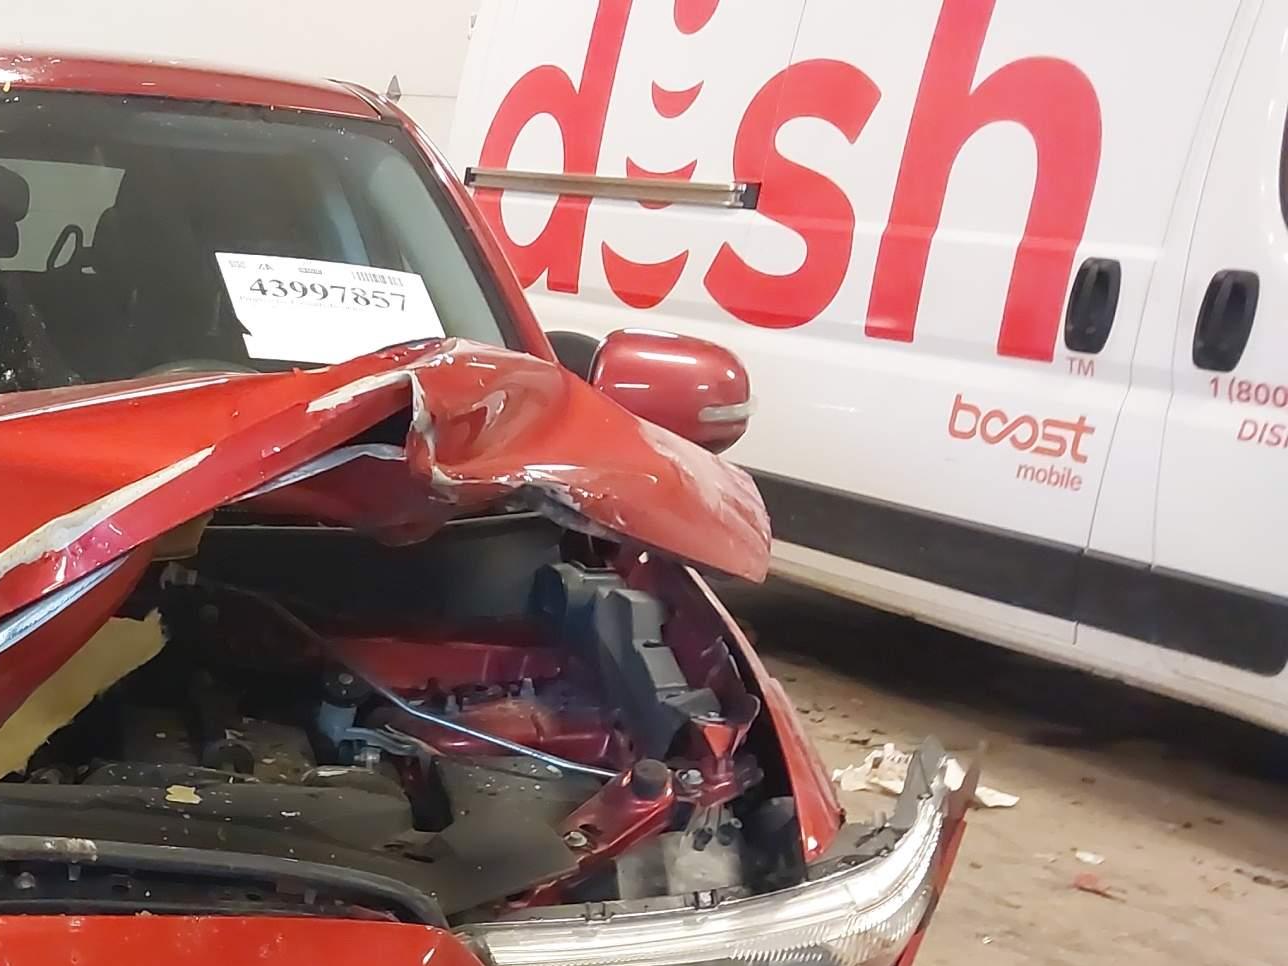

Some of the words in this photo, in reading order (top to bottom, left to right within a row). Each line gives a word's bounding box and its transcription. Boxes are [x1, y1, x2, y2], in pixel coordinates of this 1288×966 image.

[473, 0, 1102, 362] dish
[249, 277, 407, 312] 43997857
[1065, 357, 1096, 377] TM
[948, 394, 1096, 464] boost
[1237, 419, 1288, 448] DIS
[1016, 464, 1083, 492] mobile
